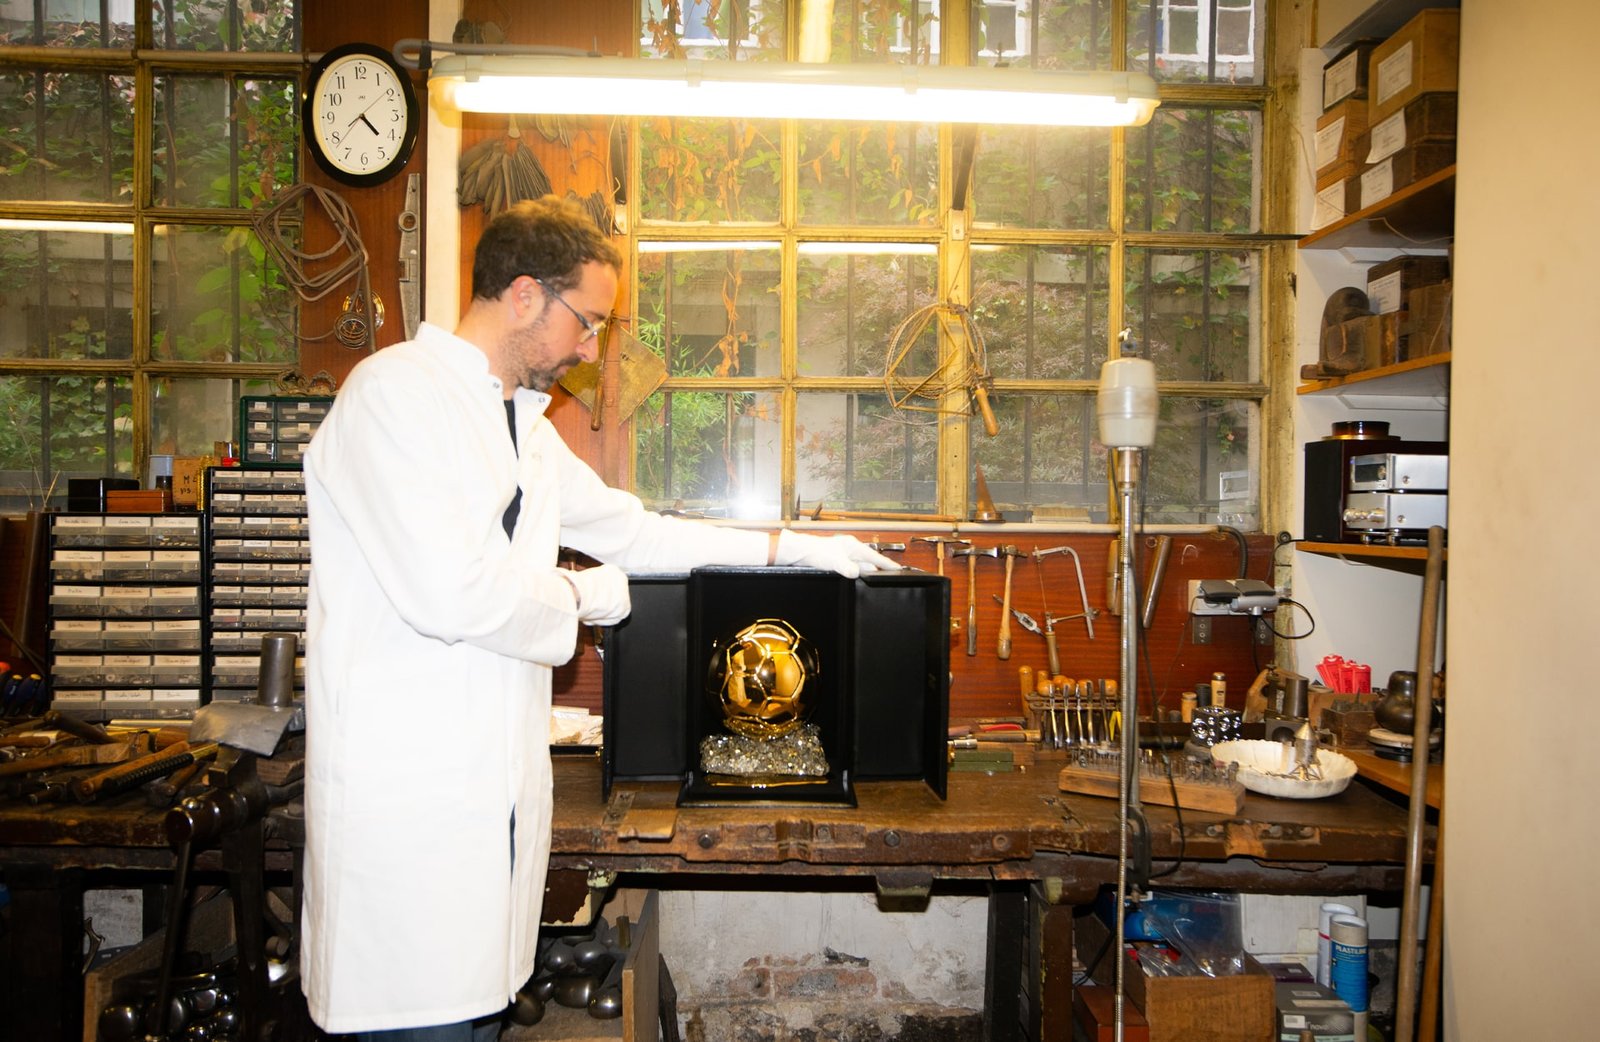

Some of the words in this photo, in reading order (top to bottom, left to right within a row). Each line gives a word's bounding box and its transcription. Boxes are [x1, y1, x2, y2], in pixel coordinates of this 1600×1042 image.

[355, 66, 367, 80] 12
[337, 76, 345, 89] 11
[329, 93, 342, 106] 10
[386, 88, 395, 102] 2
[326, 112, 335, 125] 9
[390, 109, 399, 122] 3
[331, 131, 340, 144] 8
[387, 128, 396, 141] 4
[344, 147, 352, 160] 7
[360, 152, 369, 165] 6
[377, 147, 386, 160] 5
